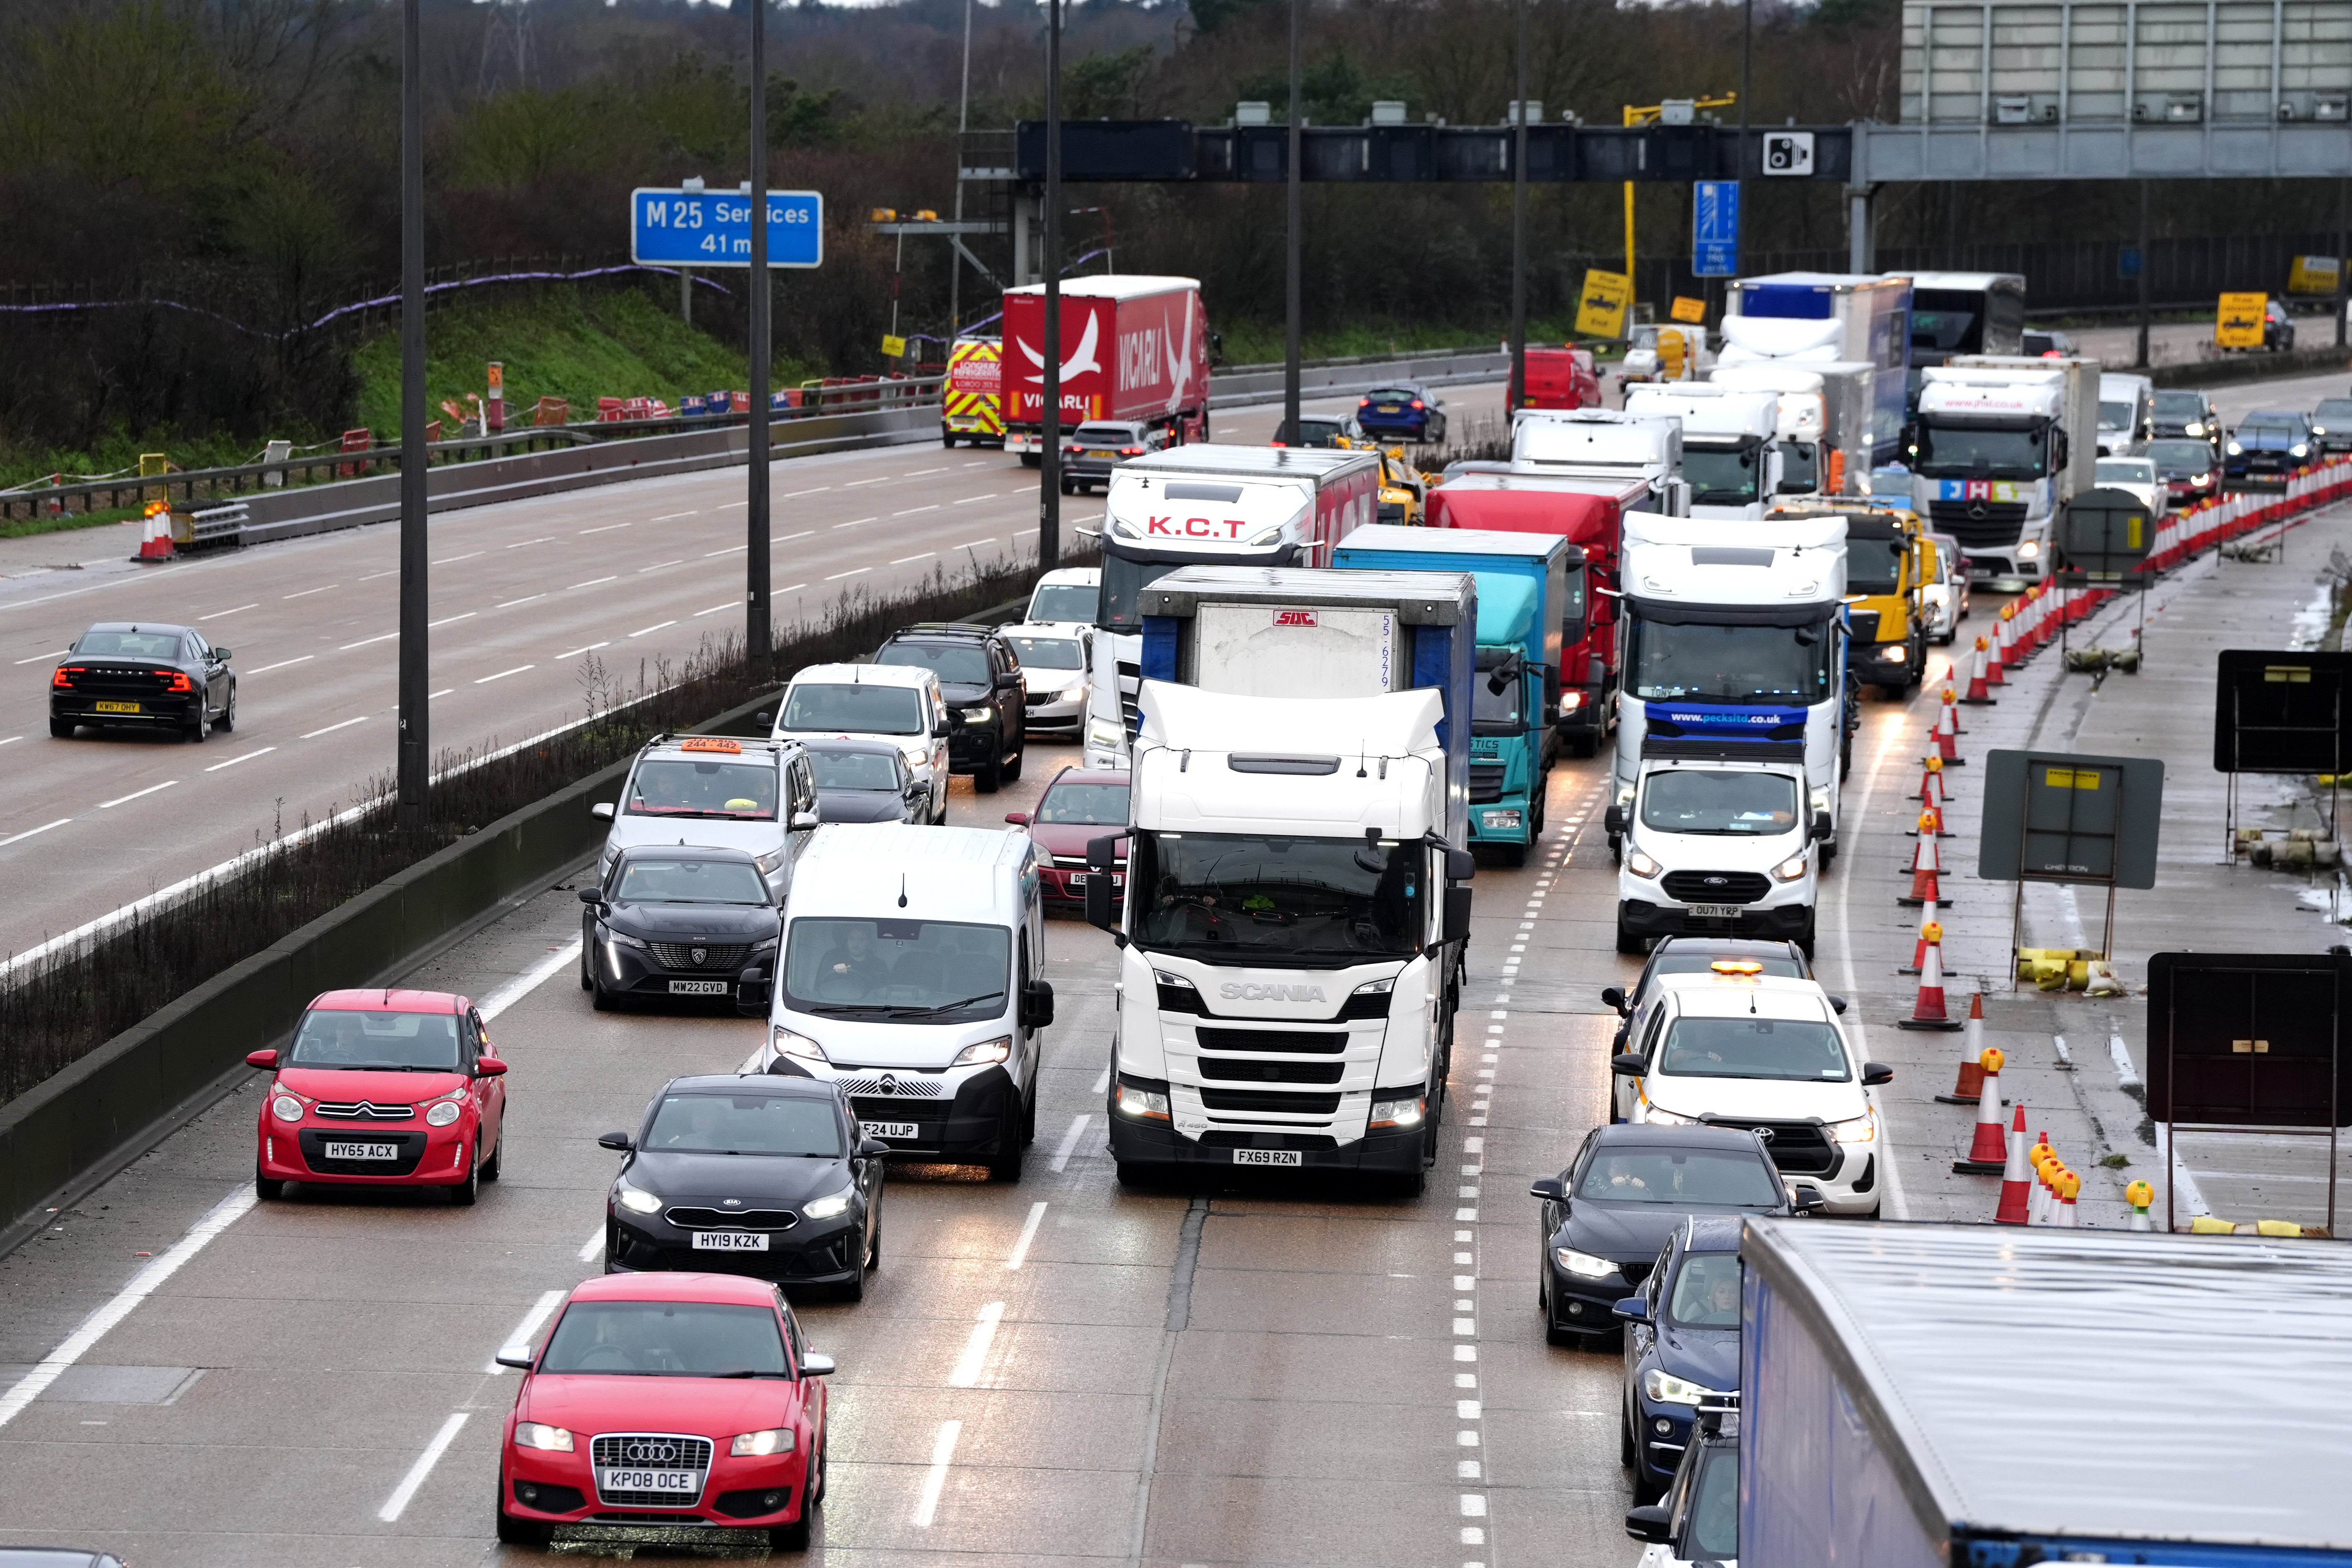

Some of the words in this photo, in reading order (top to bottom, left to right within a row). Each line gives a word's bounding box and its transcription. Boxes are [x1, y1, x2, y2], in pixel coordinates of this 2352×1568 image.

[646, 200, 667, 228] M
[673, 201, 703, 229] 25
[716, 202, 809, 224] Serices
[700, 234, 727, 253] 41
[1119, 328, 1161, 392] VICARLI
[1148, 515, 1245, 539] K.C.T
[99, 702, 118, 711] KW67
[673, 982, 700, 992] MW22
[702, 983, 723, 993] GVD
[1220, 981, 1327, 1002] SCANIA
[863, 1123, 887, 1135] E24
[890, 1125, 913, 1136] UJP
[331, 1144, 365, 1156] HY65
[368, 1145, 393, 1157] ACX
[1239, 1151, 1270, 1163] FX69
[1273, 1152, 1297, 1164] RZN
[701, 1234, 730, 1247] HY19
[734, 1235, 760, 1248] KZK
[610, 1472, 652, 1487] KP08
[657, 1474, 689, 1489] OCE
